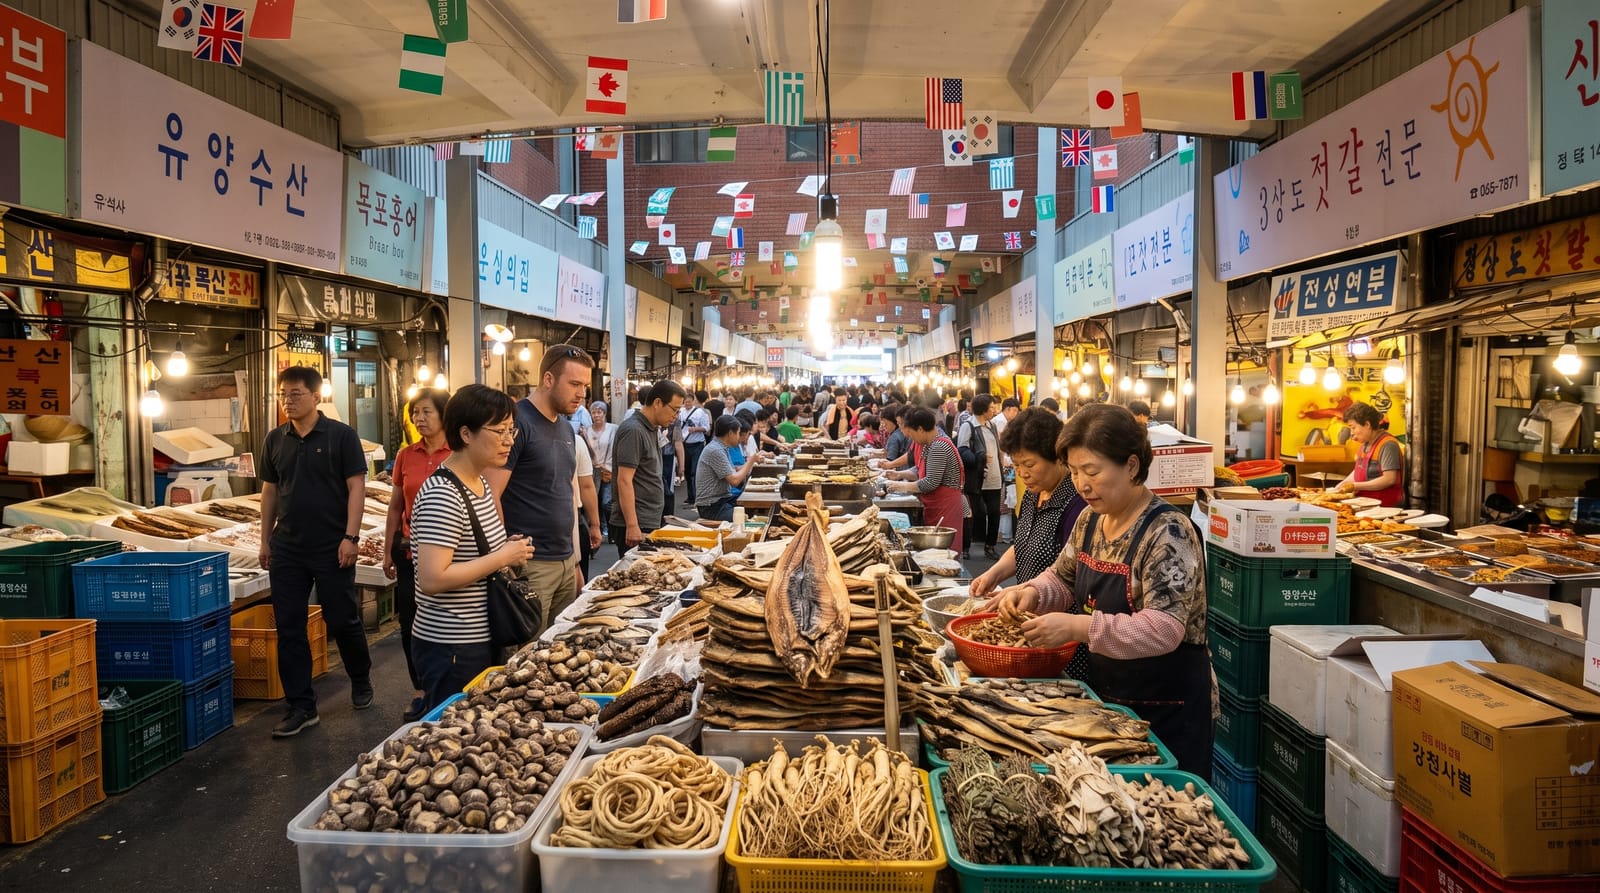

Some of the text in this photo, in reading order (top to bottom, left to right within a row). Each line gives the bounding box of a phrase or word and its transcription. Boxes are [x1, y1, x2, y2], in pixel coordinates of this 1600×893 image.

[0, 27, 48, 115] 부
[158, 112, 308, 217] 유양수산
[1376, 119, 1422, 186] 전문
[355, 181, 418, 242] 목포홍어
[1304, 264, 1386, 310] 전성연분
